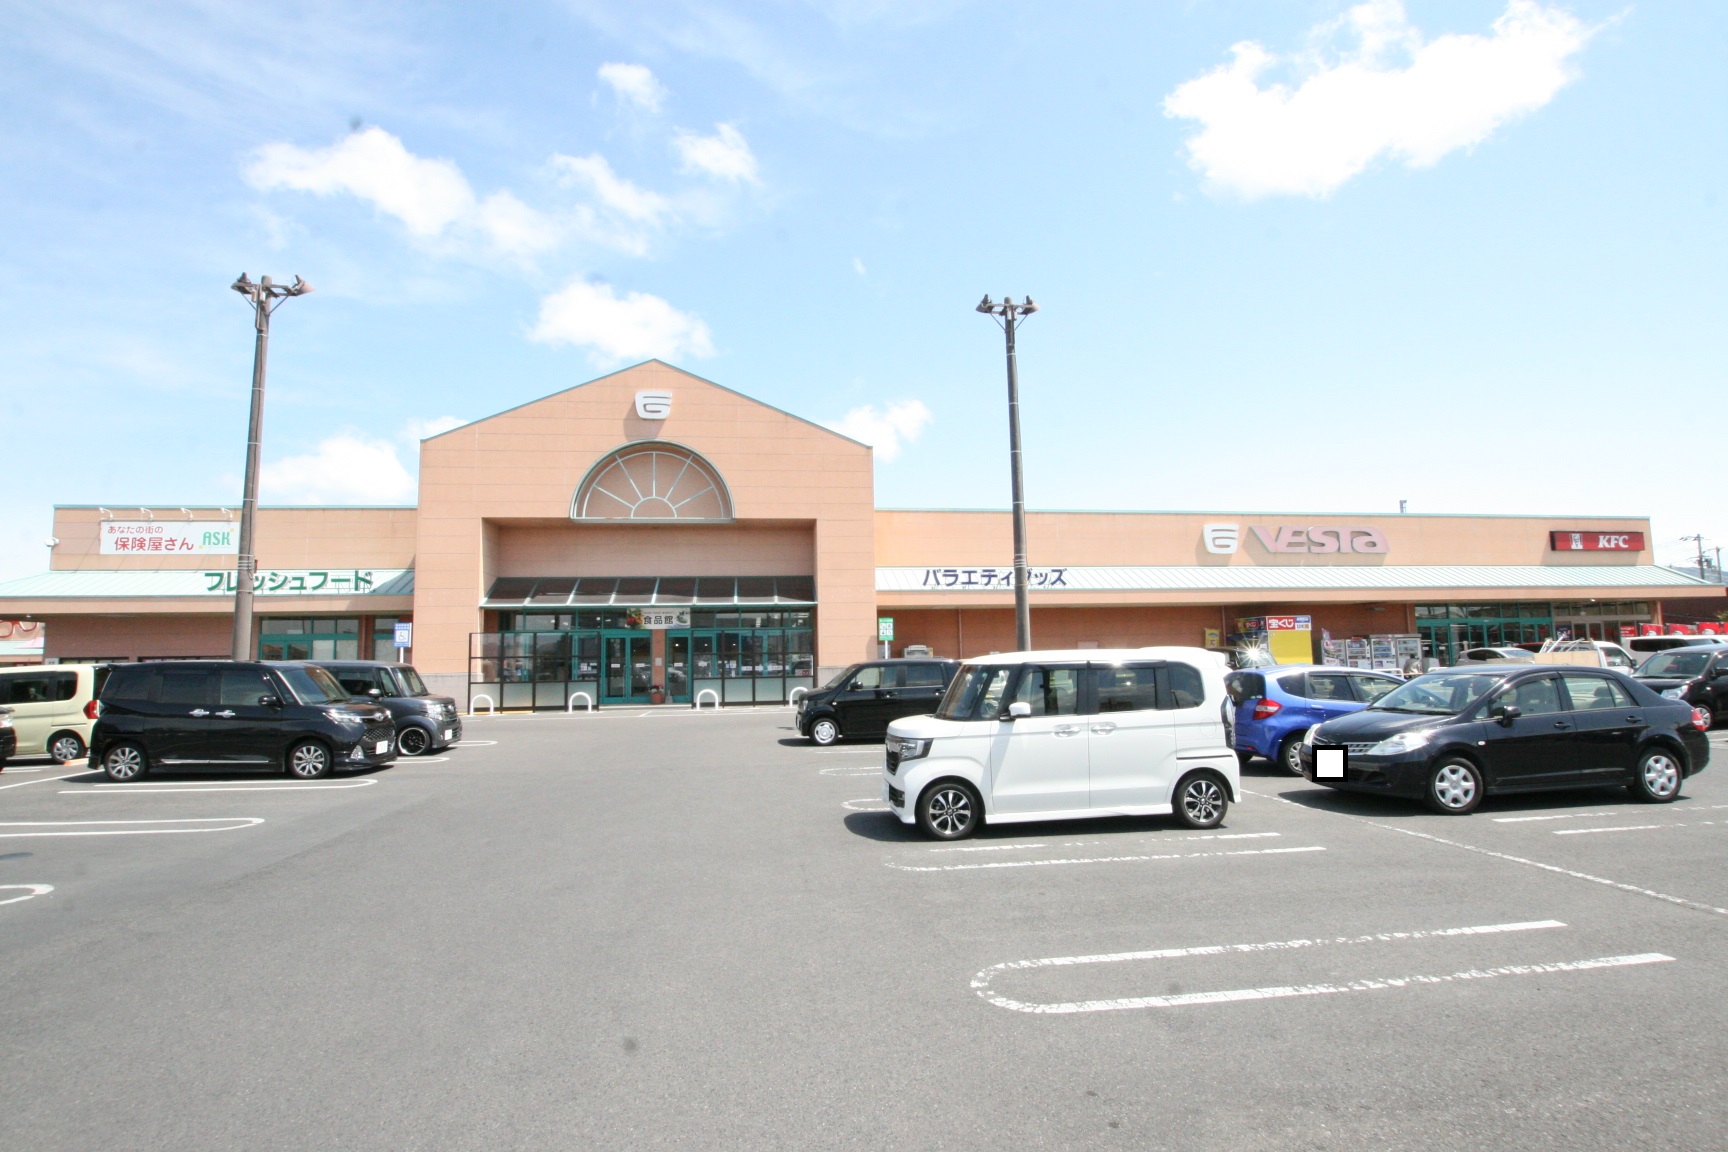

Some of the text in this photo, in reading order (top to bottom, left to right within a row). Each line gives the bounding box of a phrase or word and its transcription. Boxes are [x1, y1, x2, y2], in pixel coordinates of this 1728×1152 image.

[107, 525, 164, 534] あなたの街の
[114, 536, 194, 551] 保険屋さん
[202, 531, 231, 546] ASK
[1597, 535, 1629, 549] KFC
[643, 615, 674, 625] 食品館
[1268, 618, 1295, 629] 宝くじ
